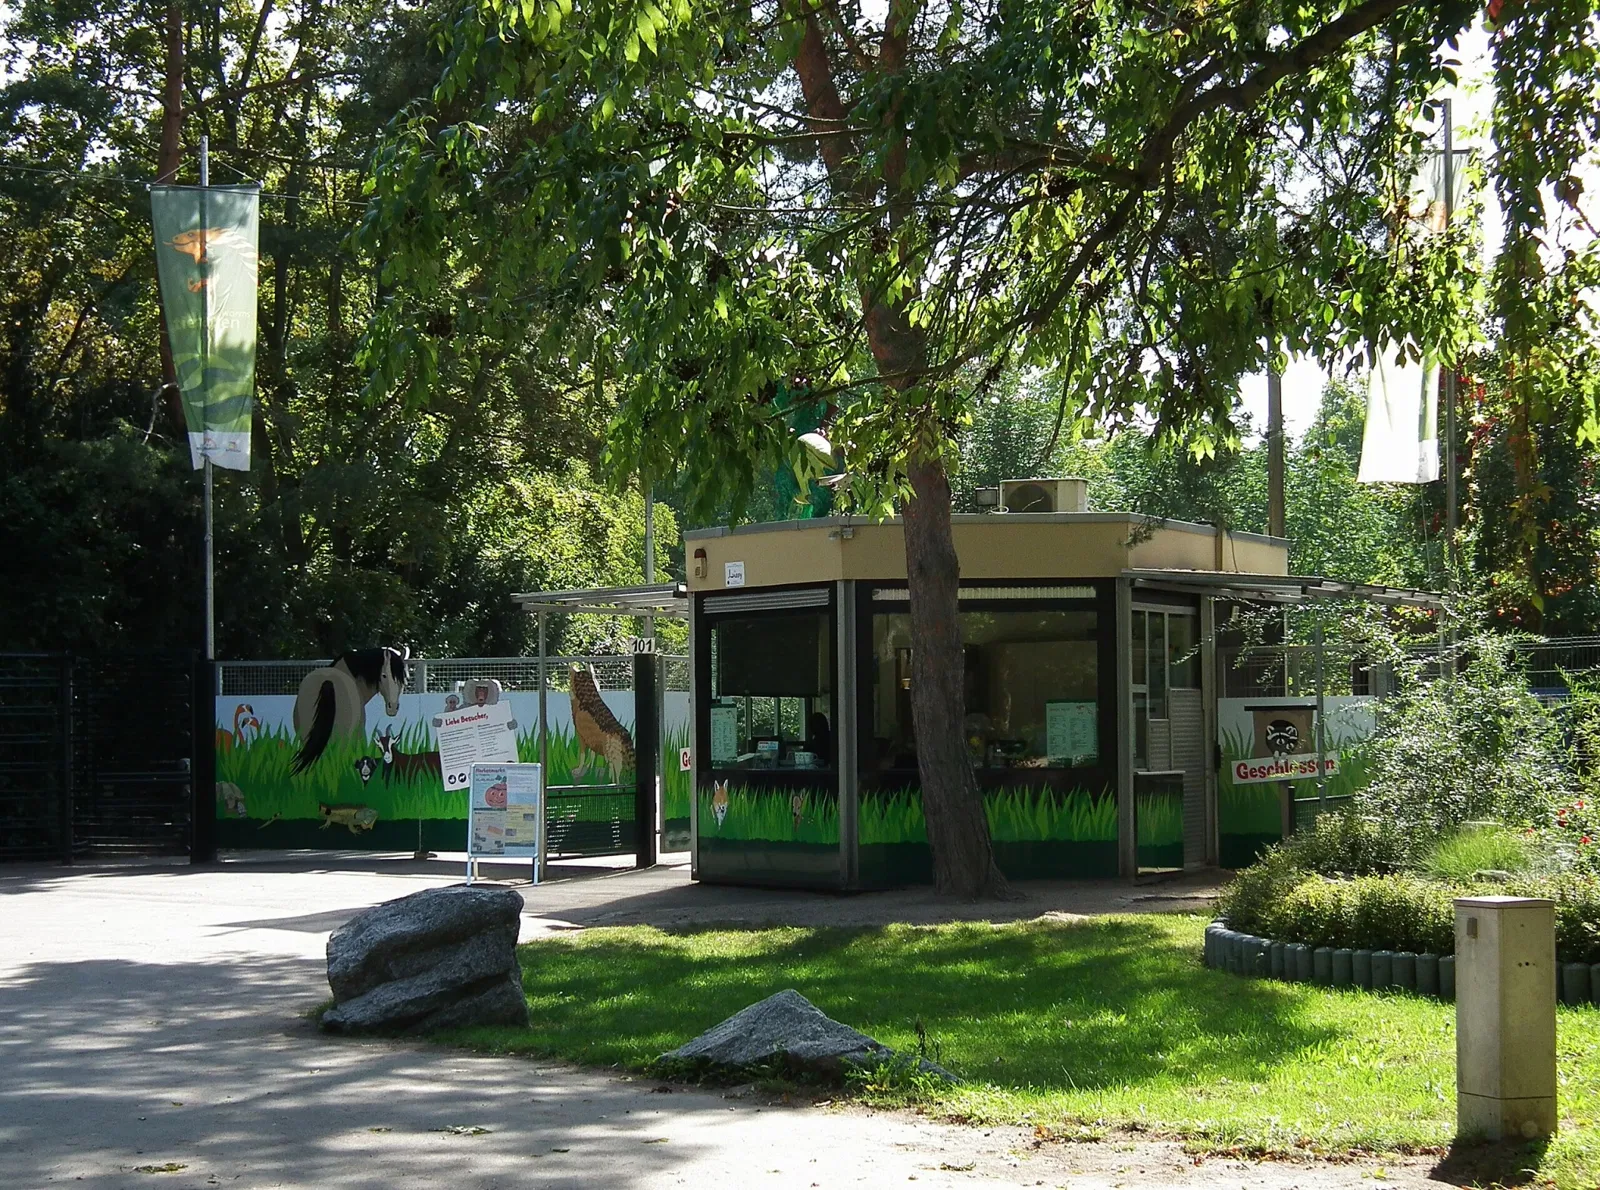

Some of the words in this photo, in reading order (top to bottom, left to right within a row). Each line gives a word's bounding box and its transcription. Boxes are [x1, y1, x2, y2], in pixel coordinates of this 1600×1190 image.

[632, 639, 652, 652] 101
[445, 717, 460, 726] Liebe
[461, 712, 489, 723] Besucher,
